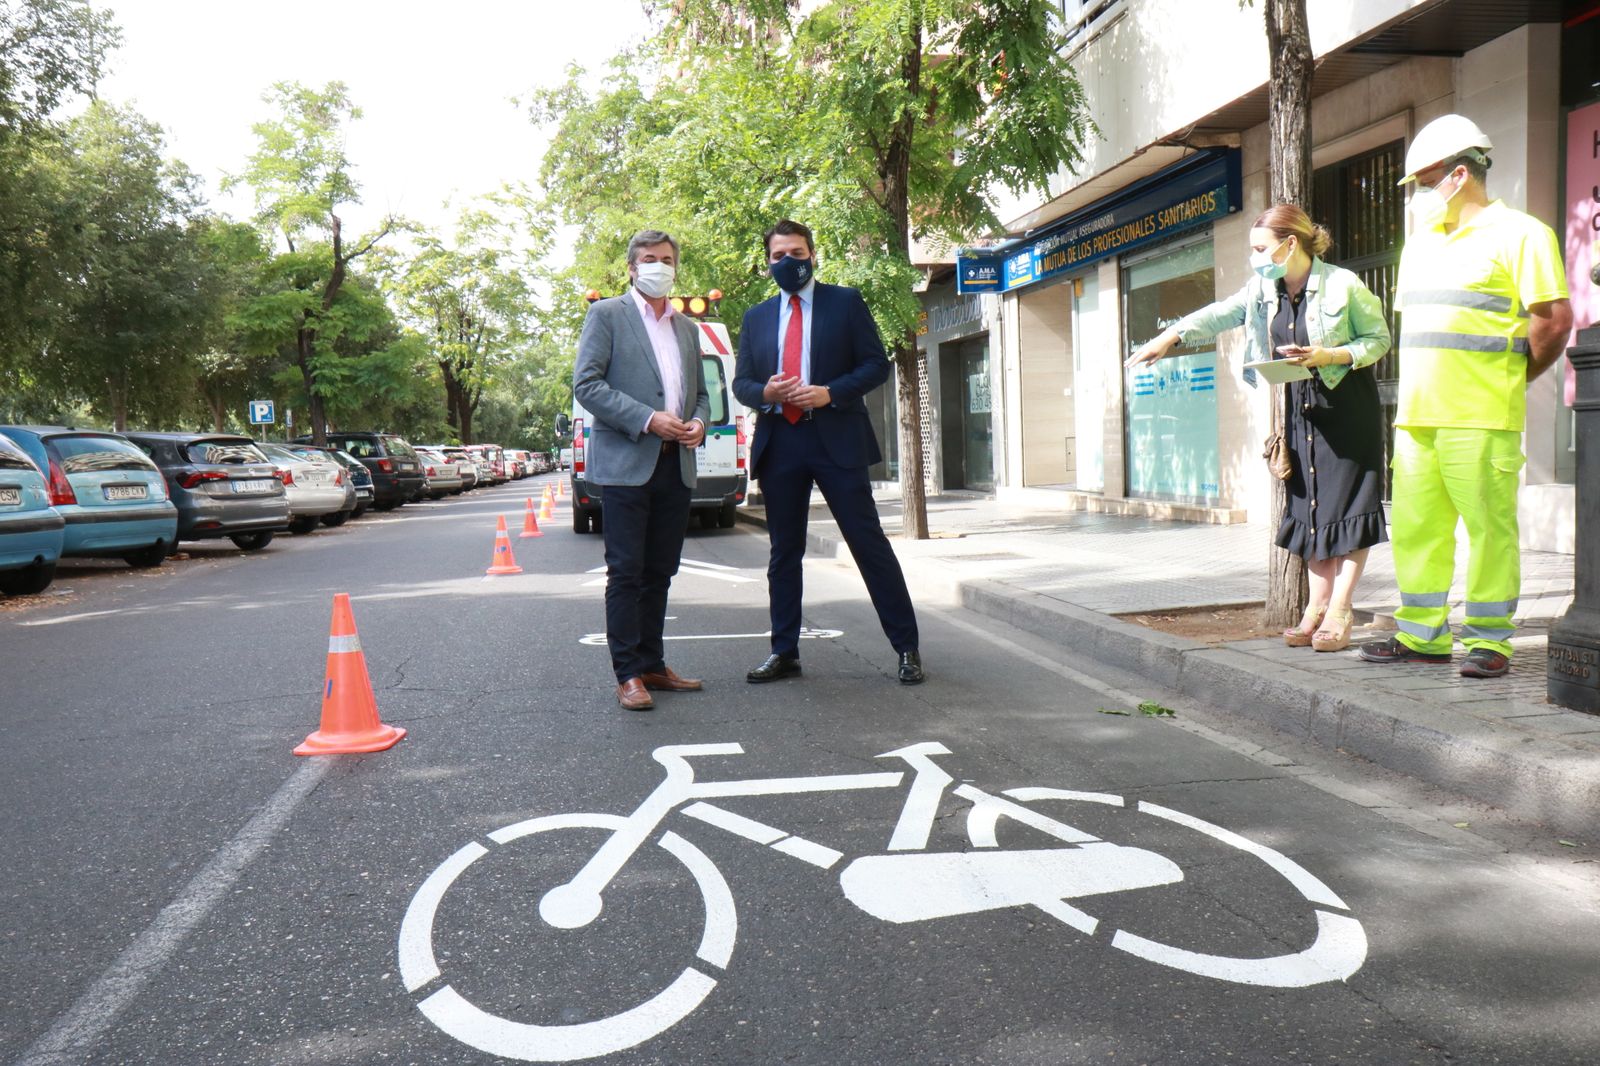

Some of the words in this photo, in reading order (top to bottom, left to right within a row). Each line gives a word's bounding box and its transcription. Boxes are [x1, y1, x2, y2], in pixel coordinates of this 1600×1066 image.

[1035, 260, 1044, 276] LA
[1044, 250, 1067, 272] MUTUA
[1067, 247, 1077, 263] DE
[1077, 241, 1092, 260] LOS
[1093, 214, 1156, 253] PROFESIONALES
[1158, 191, 1217, 231] SANITARIOS
[1079, 213, 1115, 239] ASEGURADORA
[255, 404, 269, 422] P
